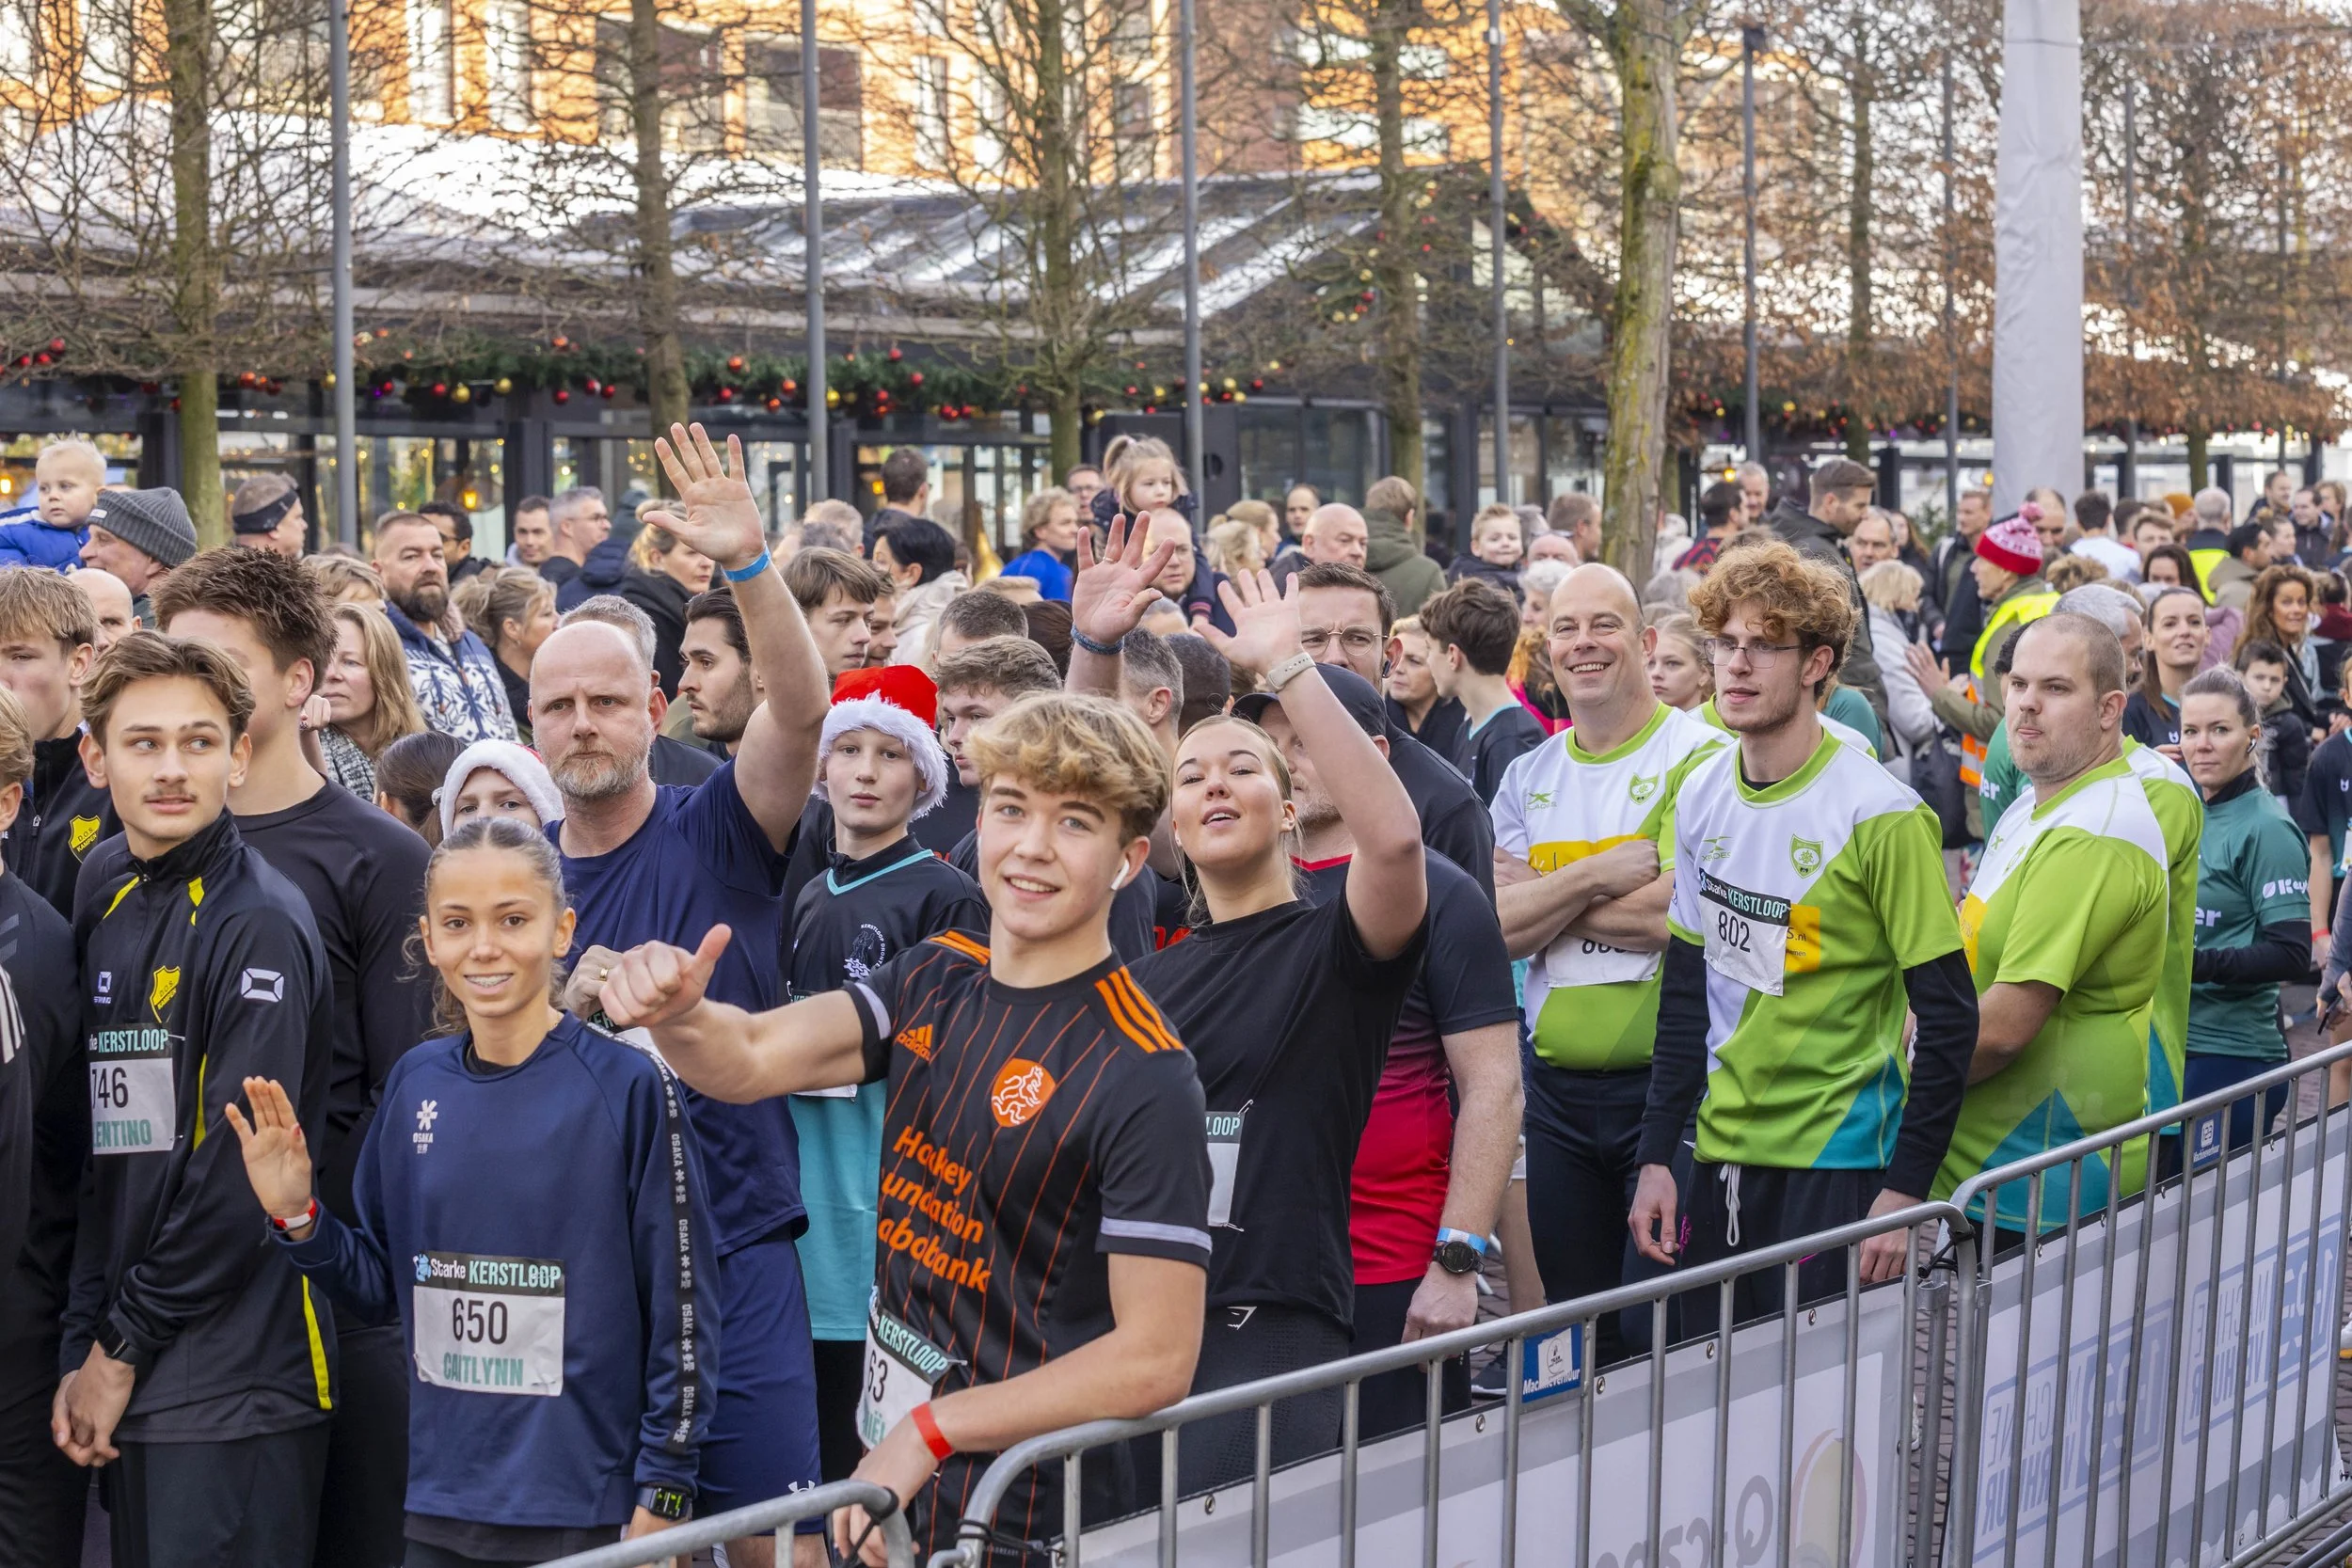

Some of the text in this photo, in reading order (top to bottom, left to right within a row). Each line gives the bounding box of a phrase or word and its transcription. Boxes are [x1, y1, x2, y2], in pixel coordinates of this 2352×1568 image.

[1707, 879, 1788, 919] Starke KERSTLOOP
[1719, 911, 1751, 953] 802
[98, 1029, 168, 1053] KERSTLOOP
[91, 1067, 129, 1109] 746
[94, 1119, 152, 1148] ENTINO
[671, 1133, 683, 1167] OSAKA
[893, 1125, 973, 1196] Hockey
[678, 1219, 690, 1252] OSAKA
[430, 1259, 562, 1289] Starke KERSTLOOP
[453, 1297, 508, 1344] 650
[681, 1304, 693, 1337] OSAKA
[878, 1315, 949, 1374] KERSTLOOP
[443, 1352, 524, 1386] CAITLYNN
[680, 1386, 694, 1417] OSAKA
